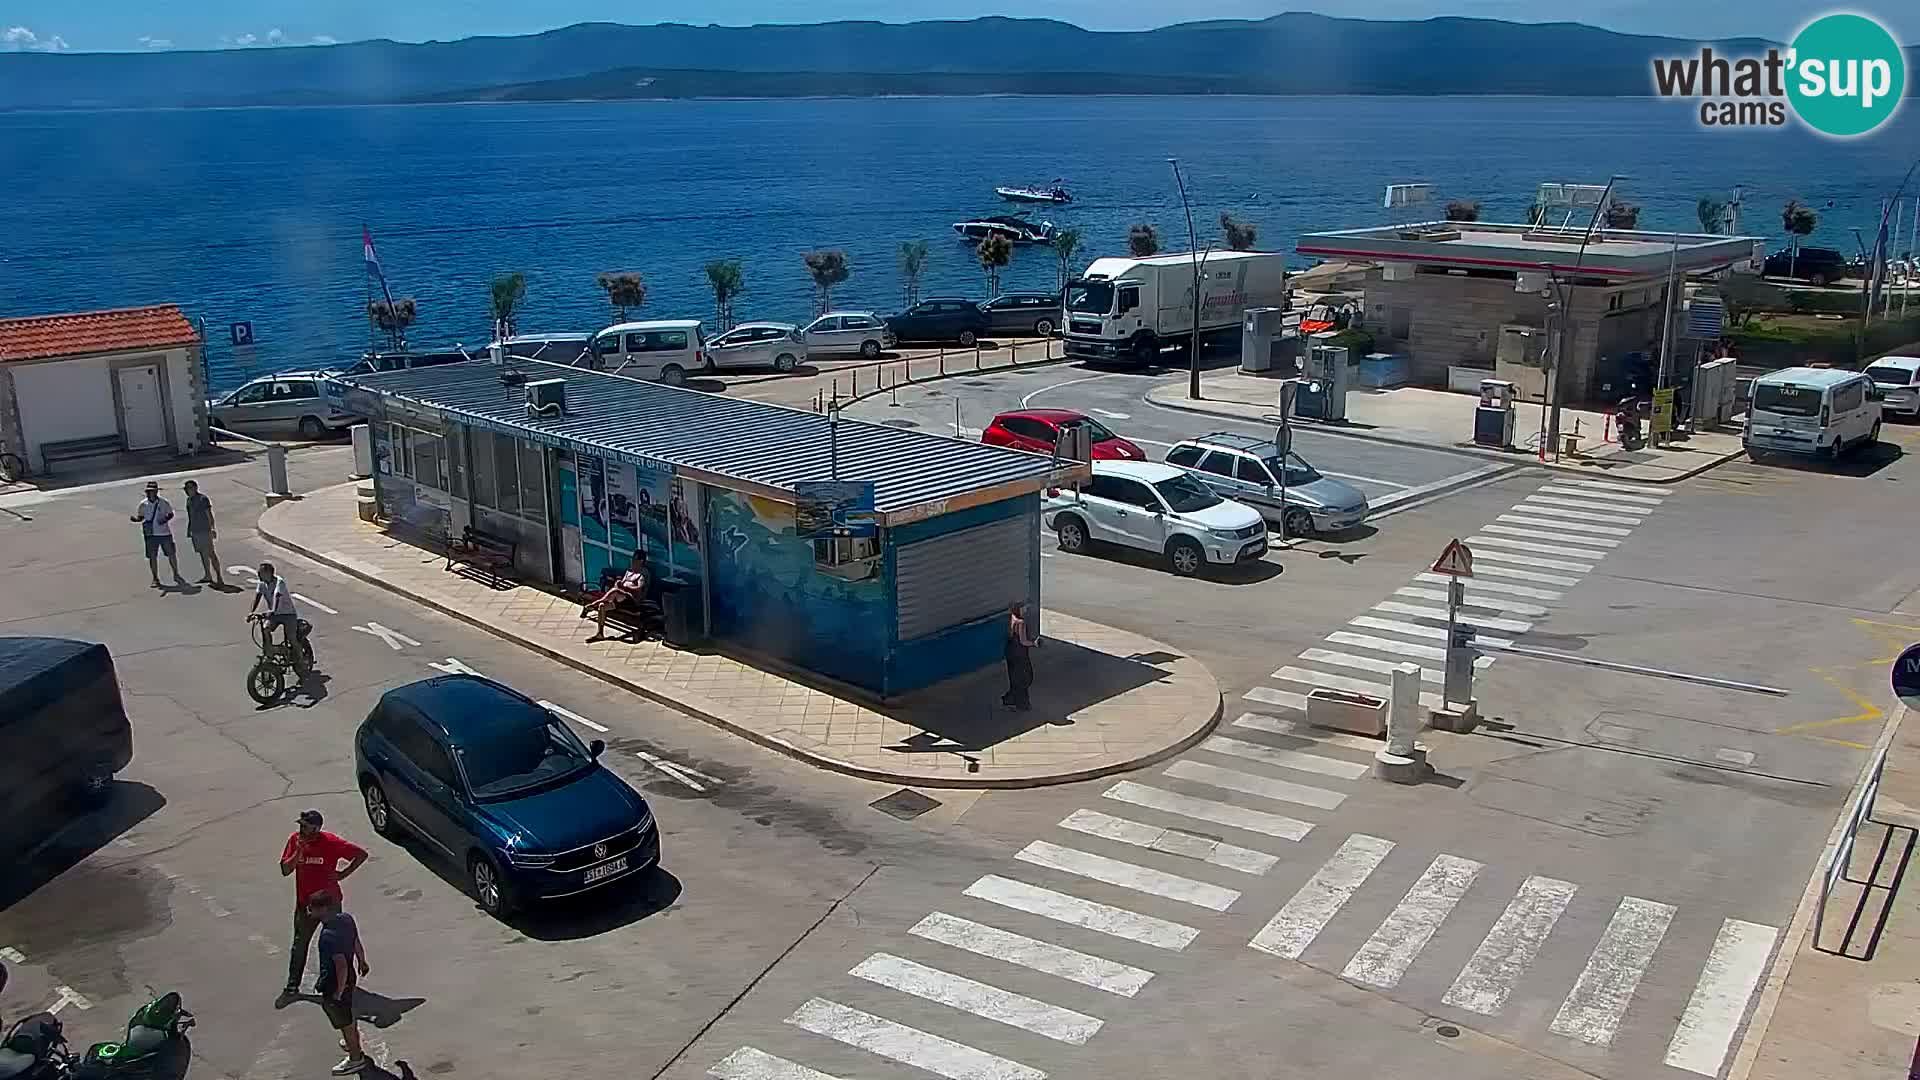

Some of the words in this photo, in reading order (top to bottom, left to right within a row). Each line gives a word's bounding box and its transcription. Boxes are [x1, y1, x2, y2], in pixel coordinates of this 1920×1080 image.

[235, 324, 248, 343] P
[1780, 388, 1799, 397] TAXI
[571, 441, 586, 453] BUS
[586, 445, 618, 461] STATION
[620, 453, 645, 467] TICKET
[646, 458, 673, 473] OFFICE
